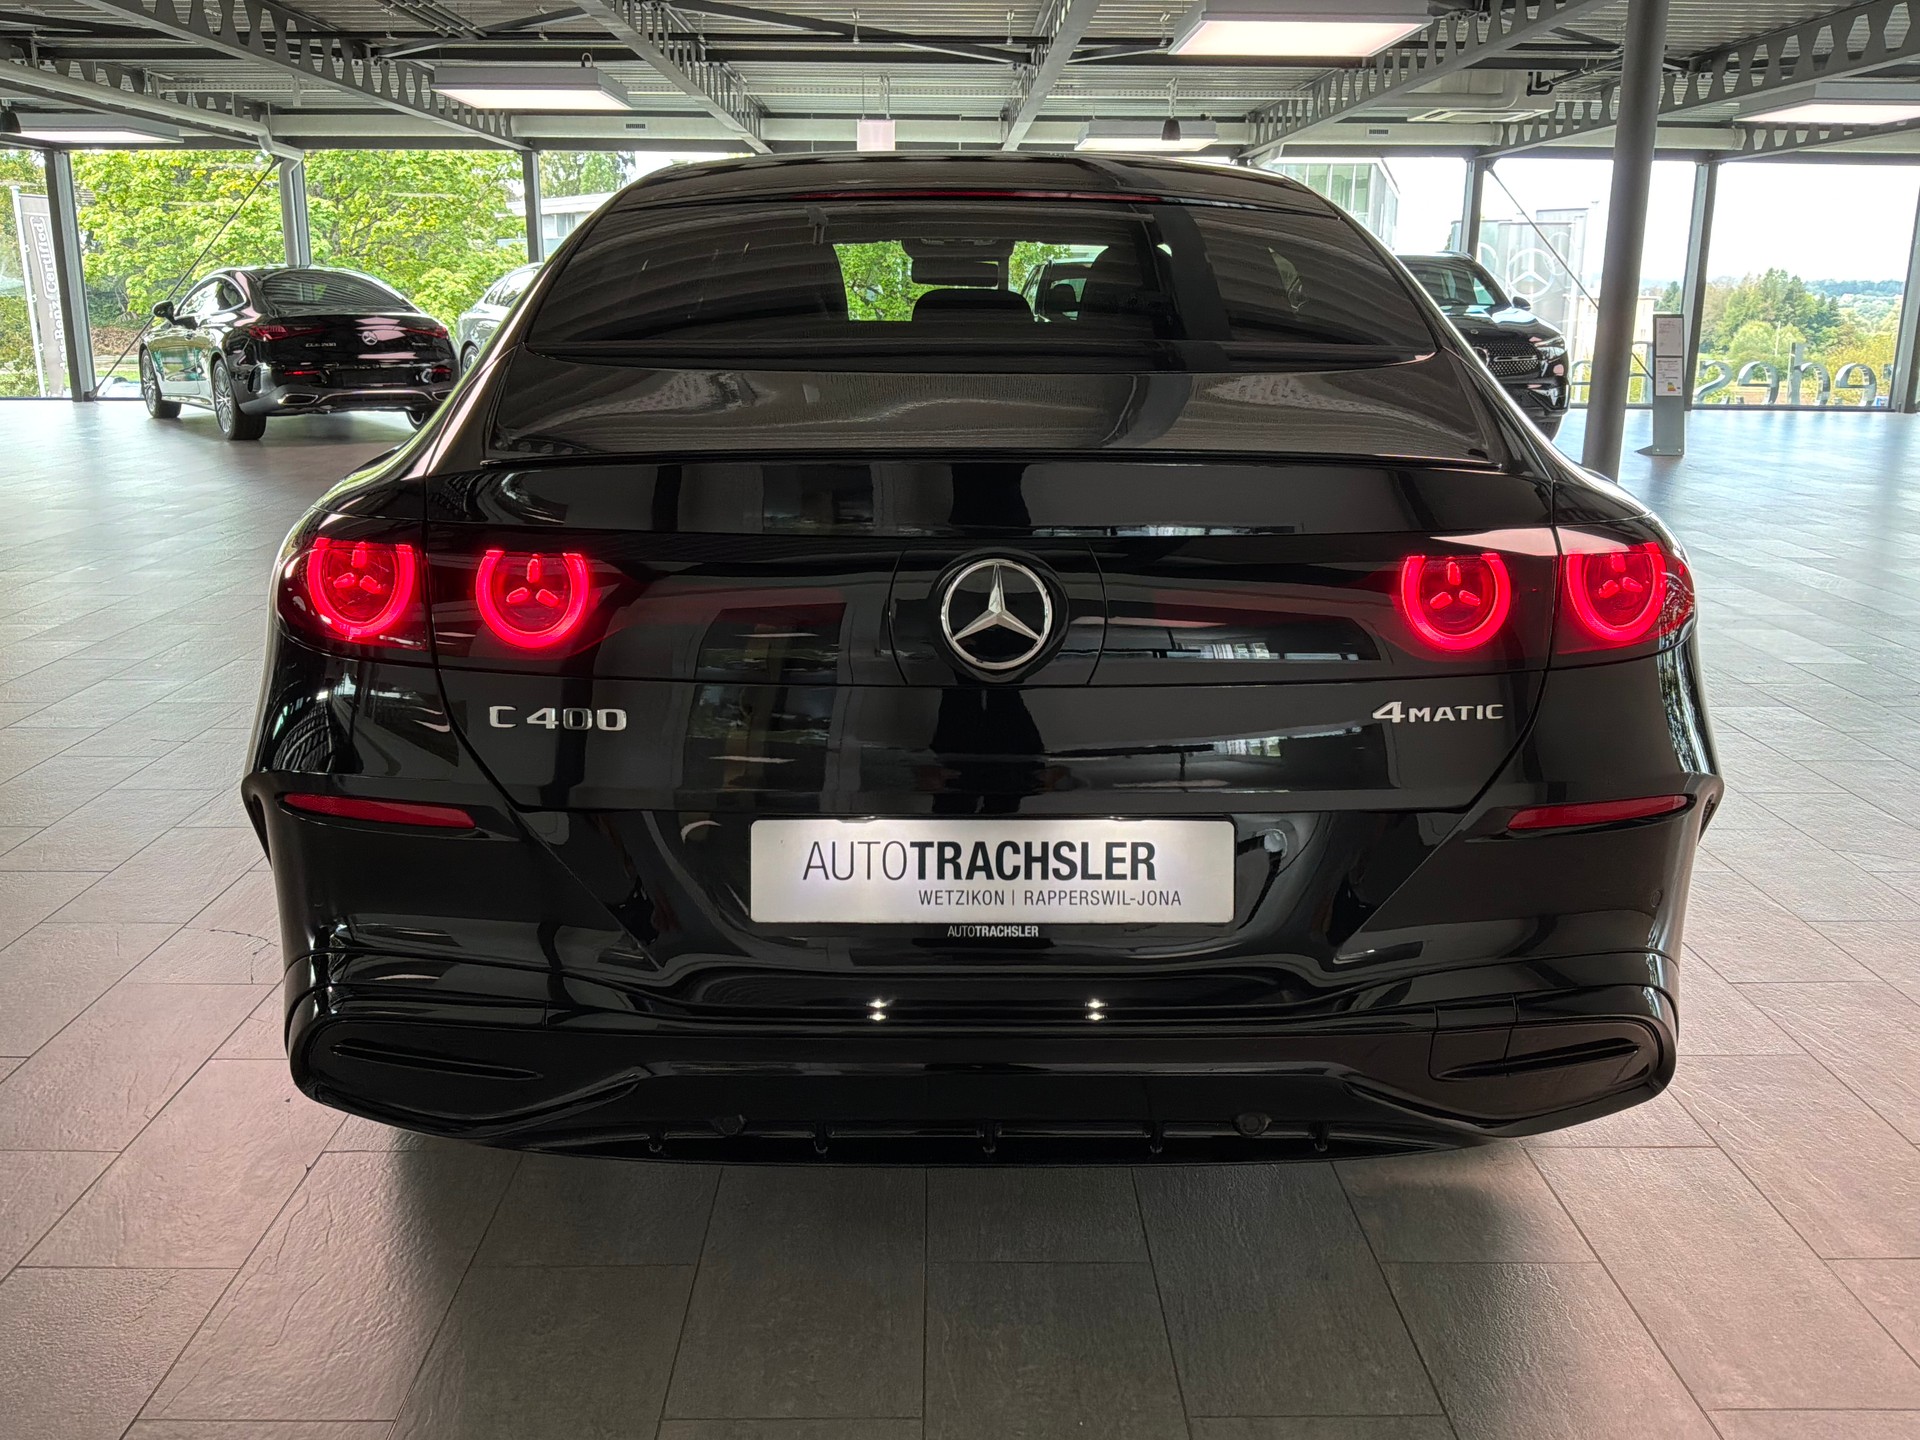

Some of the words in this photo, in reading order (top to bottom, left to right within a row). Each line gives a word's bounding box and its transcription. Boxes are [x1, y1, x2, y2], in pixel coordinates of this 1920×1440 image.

[34, 222, 58, 294] Certified
[489, 705, 517, 728] C
[526, 707, 627, 731] 400
[1372, 701, 1504, 723] 4MATIC
[802, 840, 1156, 881] AUTOTRACHSLER
[918, 889, 1005, 906] WETZIKON
[1024, 889, 1182, 906] RAPPERSWIL-JONA
[947, 925, 1039, 938] AUTOTRACHSLER
